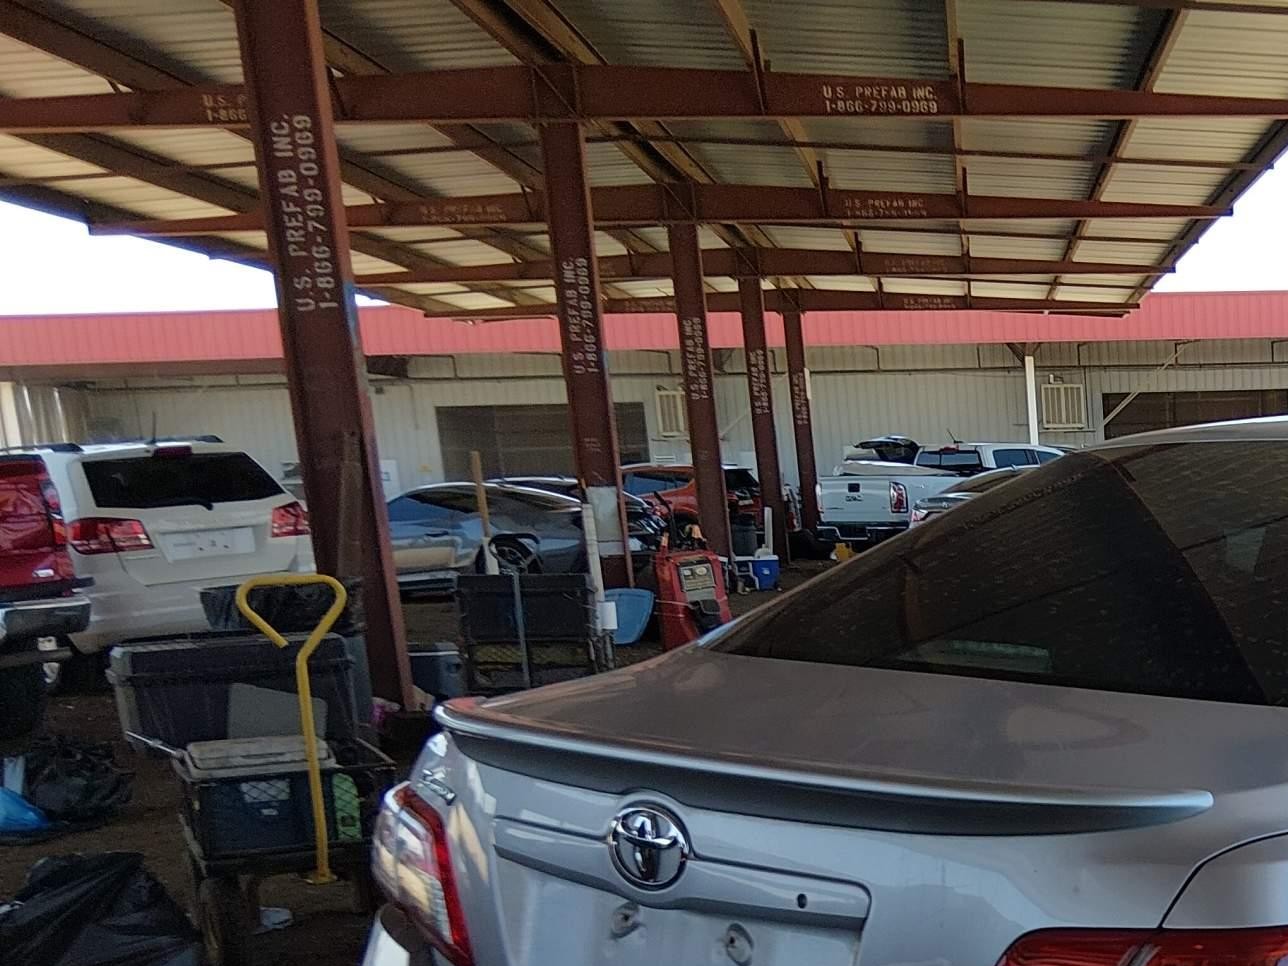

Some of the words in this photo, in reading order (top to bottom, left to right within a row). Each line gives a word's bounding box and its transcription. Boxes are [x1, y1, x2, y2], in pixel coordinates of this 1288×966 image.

[855, 86, 907, 99] PREFAB
[271, 113, 294, 157] INC.
[277, 169, 307, 257] PREFAB
[293, 114, 338, 309] 1-866-799-0969
[565, 289, 583, 342] PREFAB
